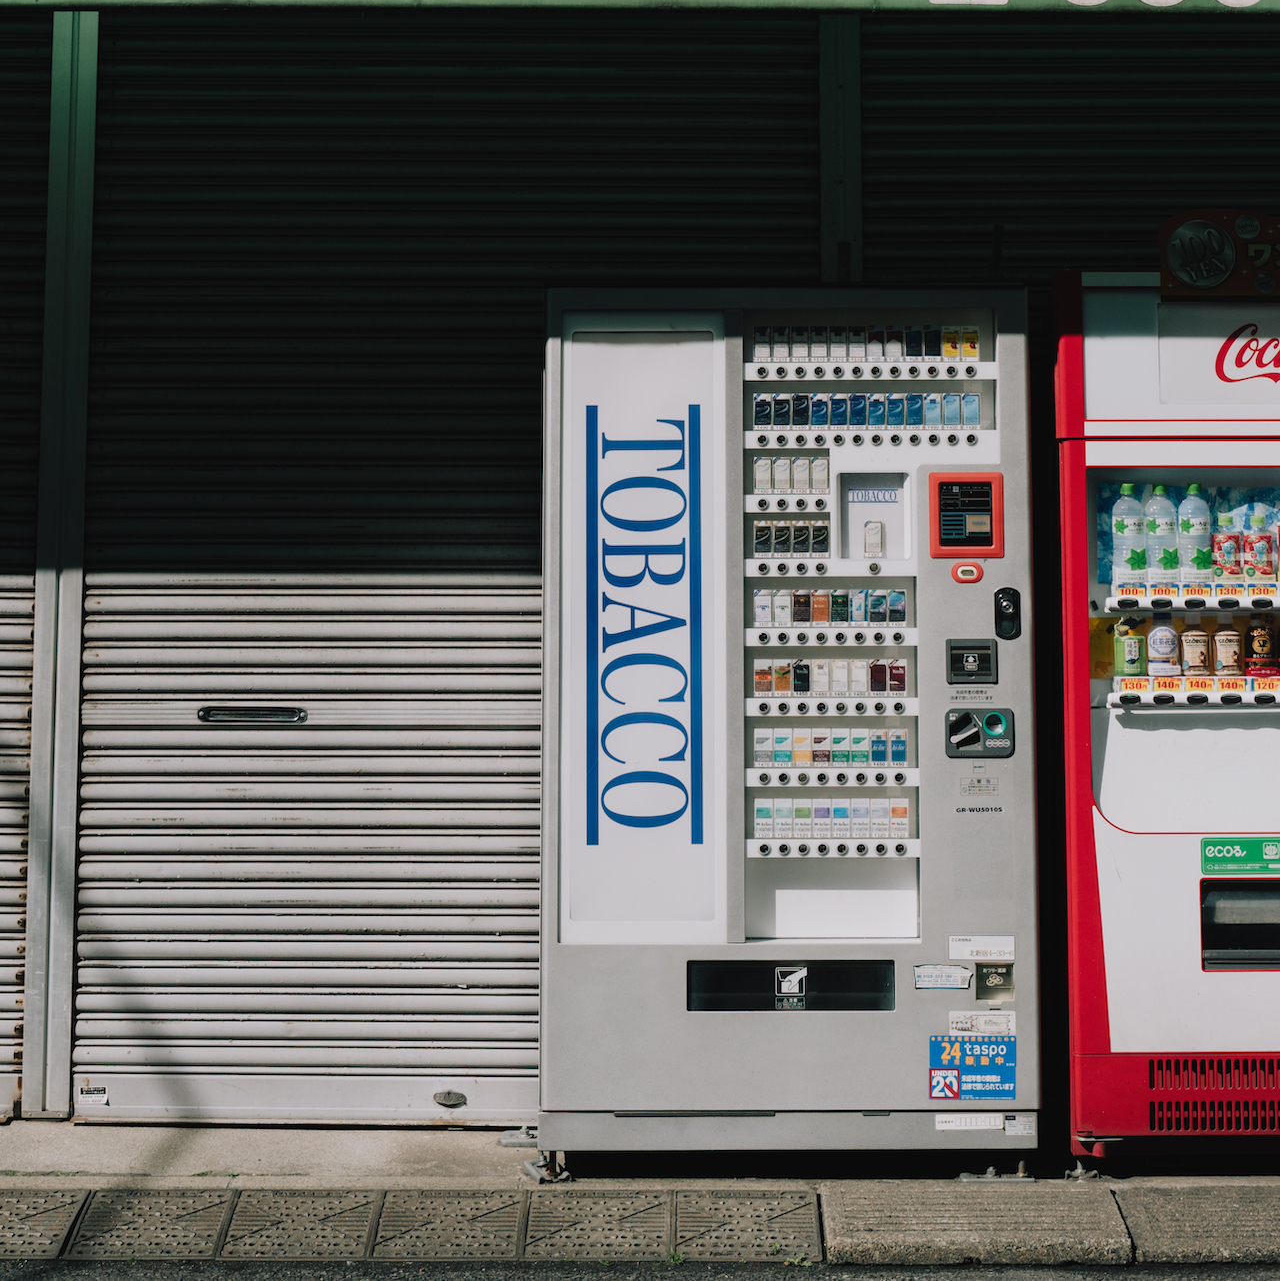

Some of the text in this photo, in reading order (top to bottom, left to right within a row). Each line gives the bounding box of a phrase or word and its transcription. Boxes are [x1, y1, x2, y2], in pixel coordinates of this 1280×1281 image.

[1170, 228, 1227, 267] 100
[1183, 256, 1228, 282] YEN
[850, 490, 897, 502] TOBACCO
[600, 419, 690, 829] TOBACCO
[941, 1042, 962, 1060] 24
[964, 1042, 1007, 1058] taspo
[932, 1076, 958, 1097] 20
